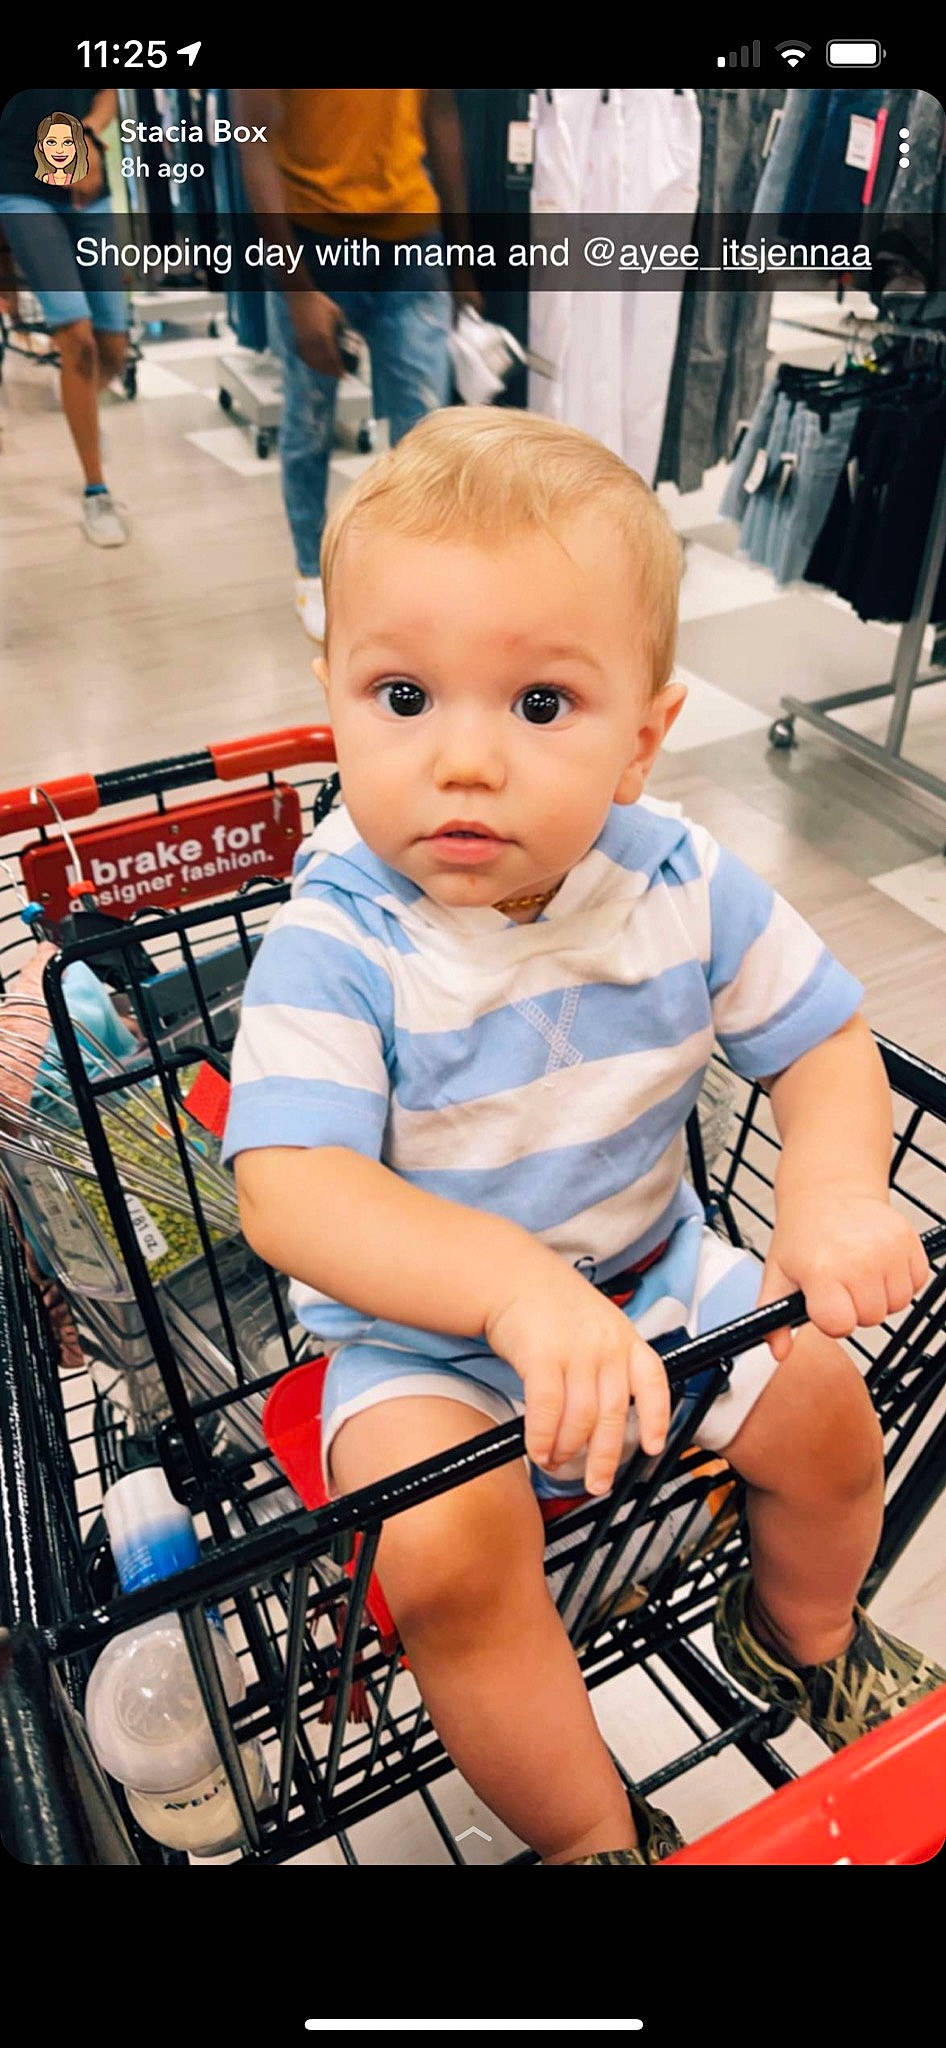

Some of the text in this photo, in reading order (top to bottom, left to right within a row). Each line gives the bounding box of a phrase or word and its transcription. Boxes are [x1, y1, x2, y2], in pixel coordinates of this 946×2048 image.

[91, 838, 202, 885] brake
[212, 821, 266, 853] for
[181, 848, 274, 883] fashion.
